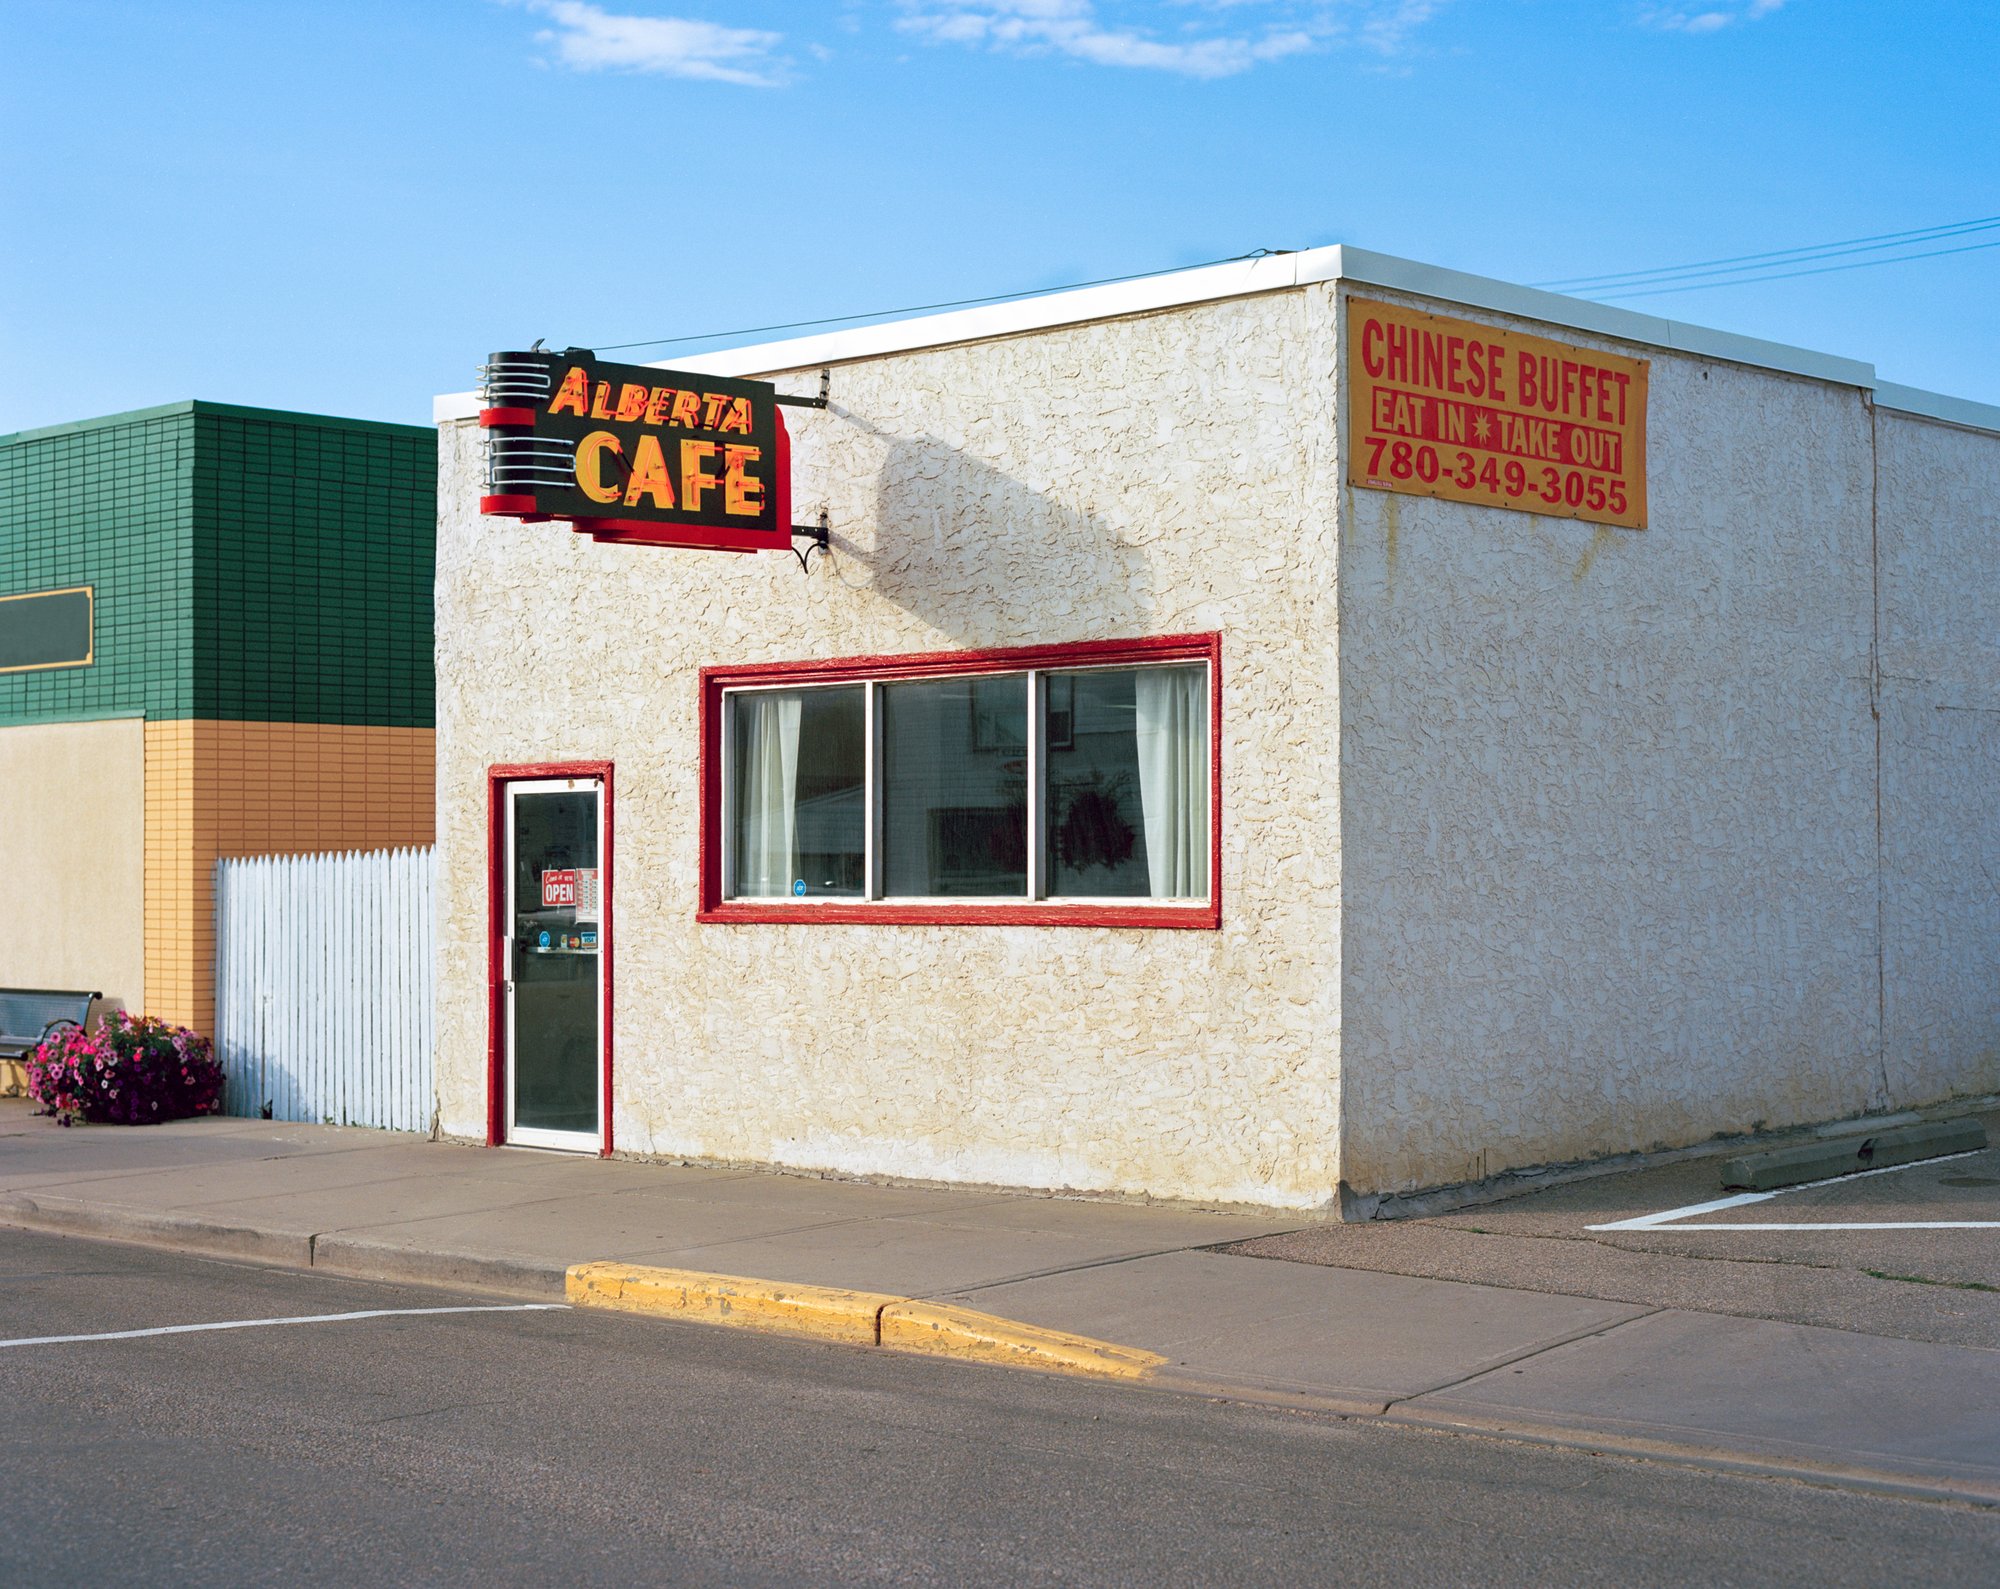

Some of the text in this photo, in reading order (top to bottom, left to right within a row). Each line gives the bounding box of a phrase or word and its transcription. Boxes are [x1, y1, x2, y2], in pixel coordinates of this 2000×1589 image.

[548, 367, 752, 435] ALBERTA
[1362, 319, 1631, 426] CHINESE BUFFET
[1376, 391, 1619, 471] EAT IN TAKE OUT
[575, 431, 765, 517] CAFE
[1364, 437, 1627, 515] 780-349-3055
[545, 884, 573, 902] OPEN
